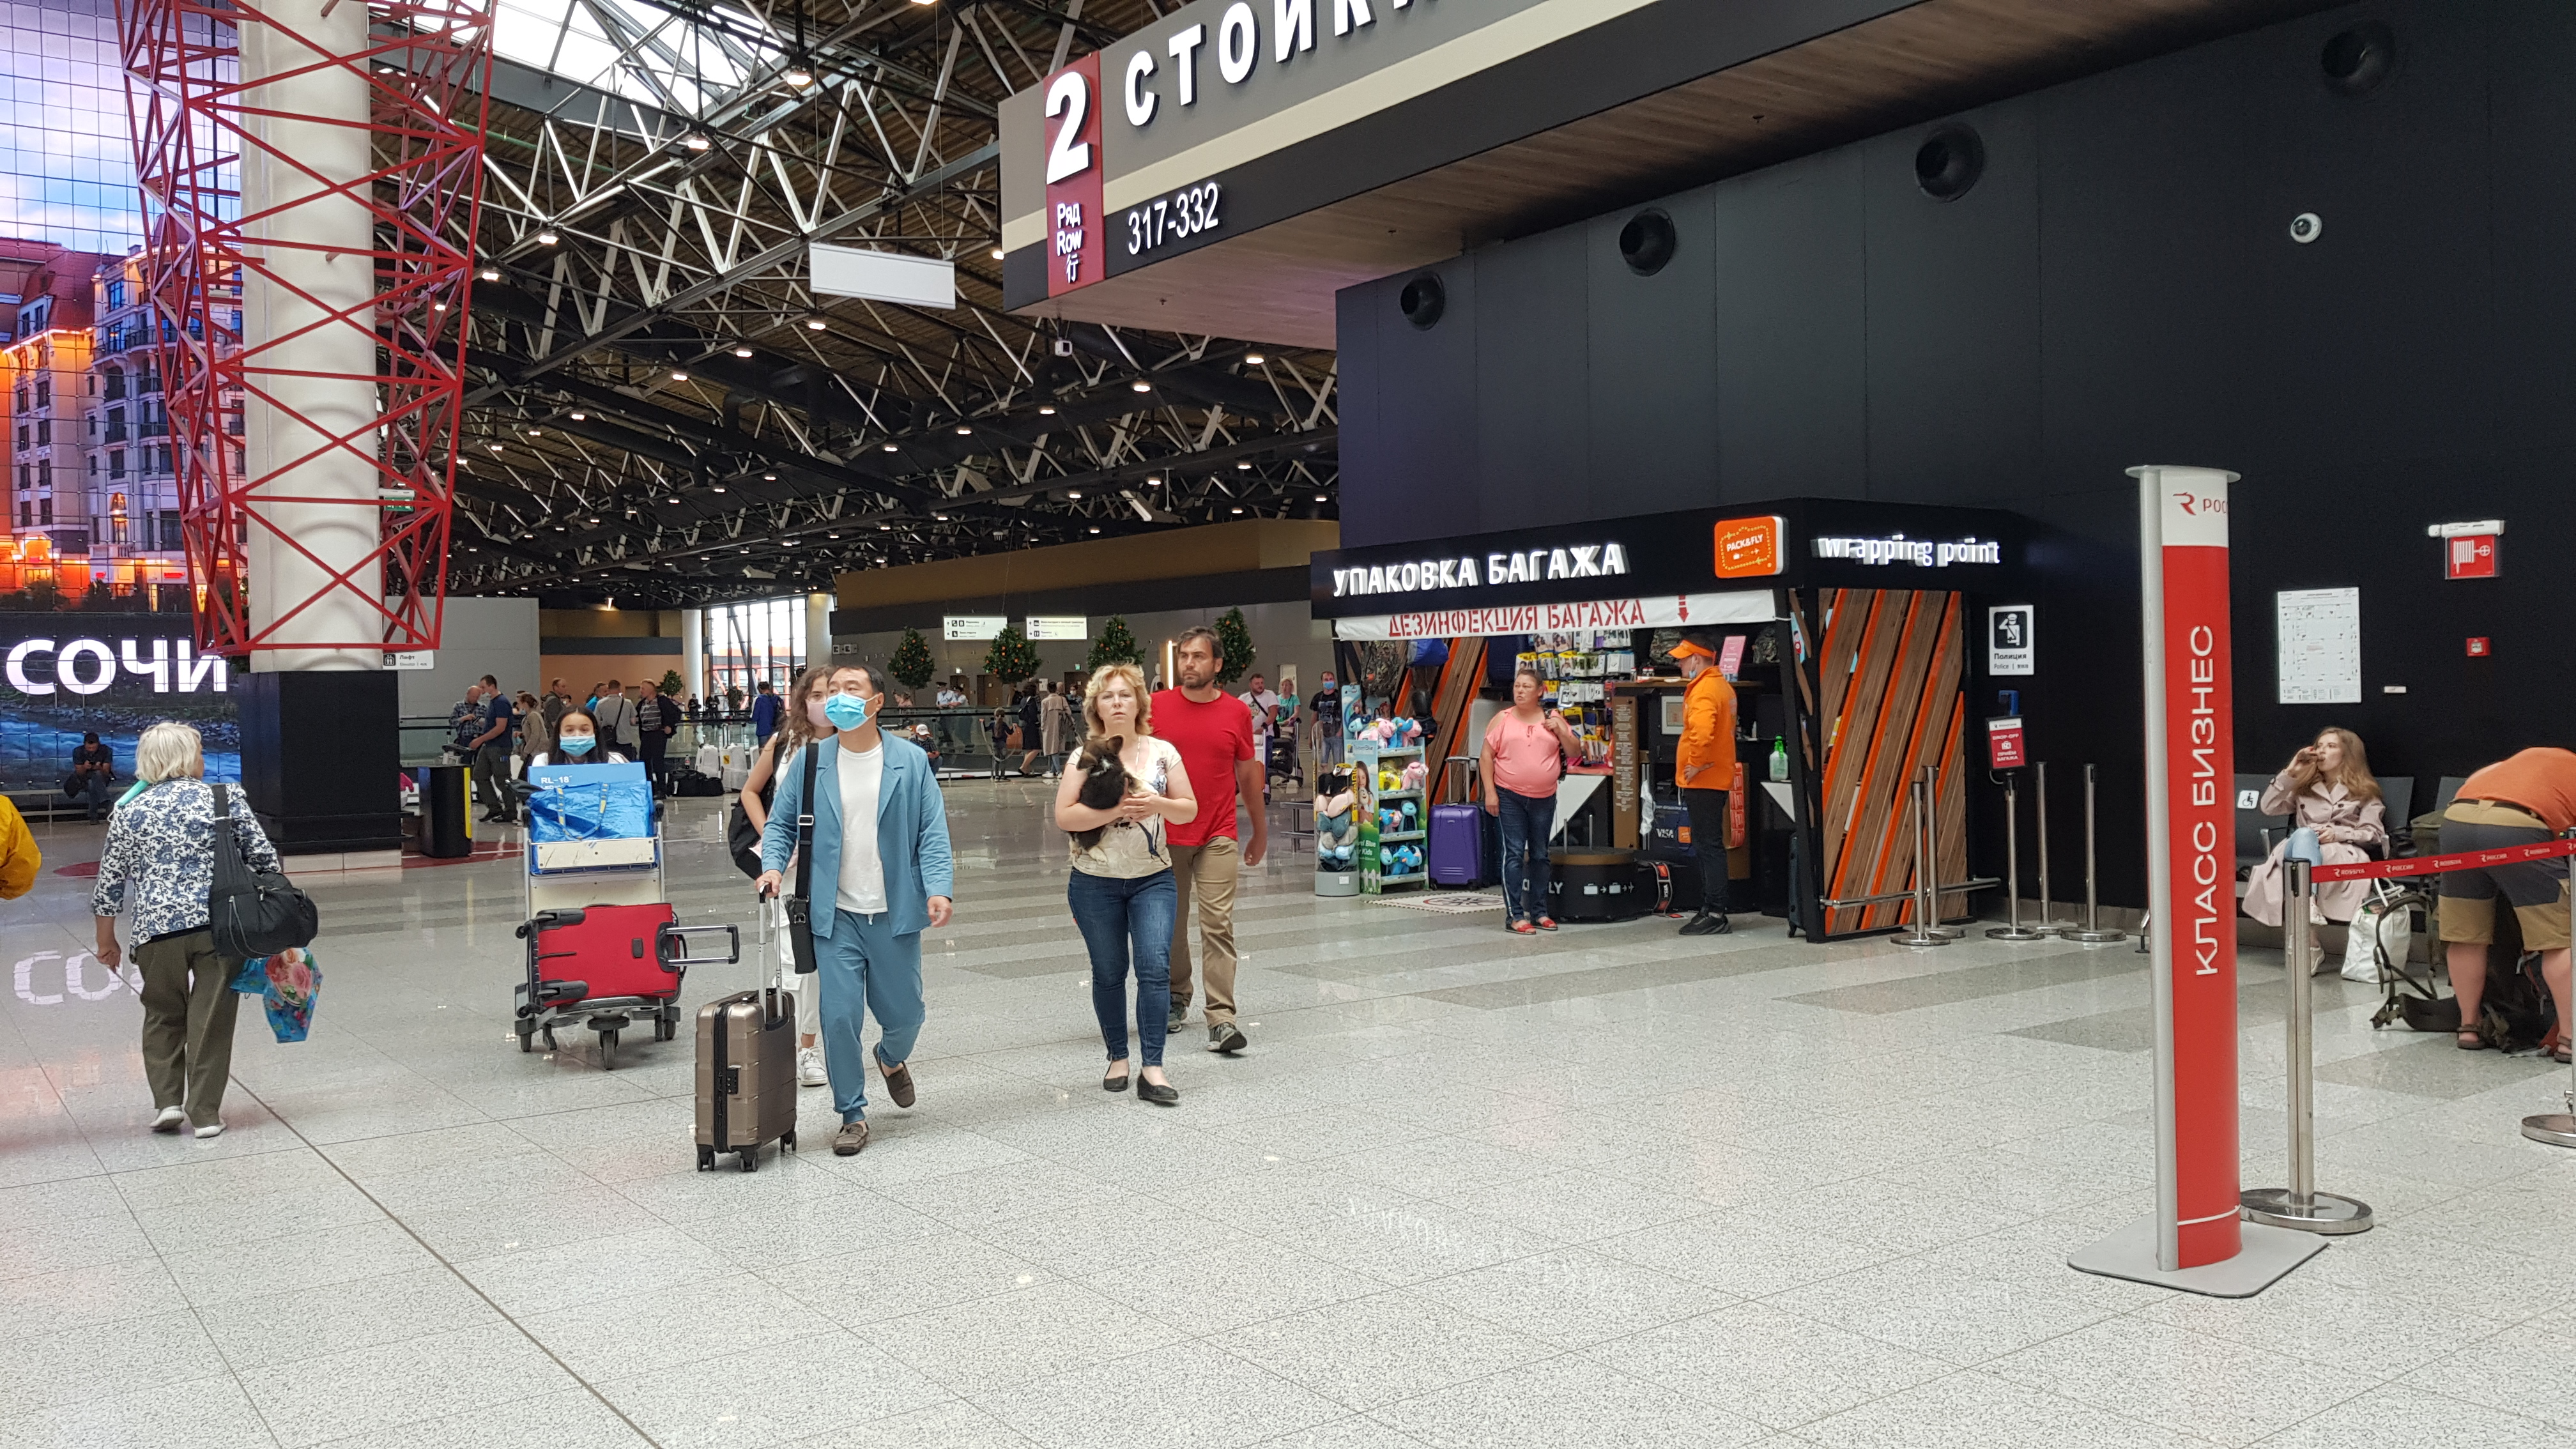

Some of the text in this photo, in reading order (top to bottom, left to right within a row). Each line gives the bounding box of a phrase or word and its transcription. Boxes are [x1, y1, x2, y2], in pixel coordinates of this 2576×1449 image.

[1045, 71, 1092, 185] 2
[1057, 203, 1081, 228] Ряд
[1128, 182, 1218, 255] 317-332
[1057, 229, 1082, 256] Row
[1066, 254, 1079, 284] 行
[1726, 534, 1763, 552] PACK&FLY
[1818, 534, 2000, 567] wrapping point
[1333, 544, 1628, 597] УПАКОВКА БАГАЖА
[1389, 599, 1646, 638] ДЕЗИНФЕКЦИЯ БАГАЖА
[6, 639, 227, 695] СОЧИ
[2190, 625, 2218, 976] КЛАСС БИЗНЕС
[1656, 828, 1673, 838] VISA
